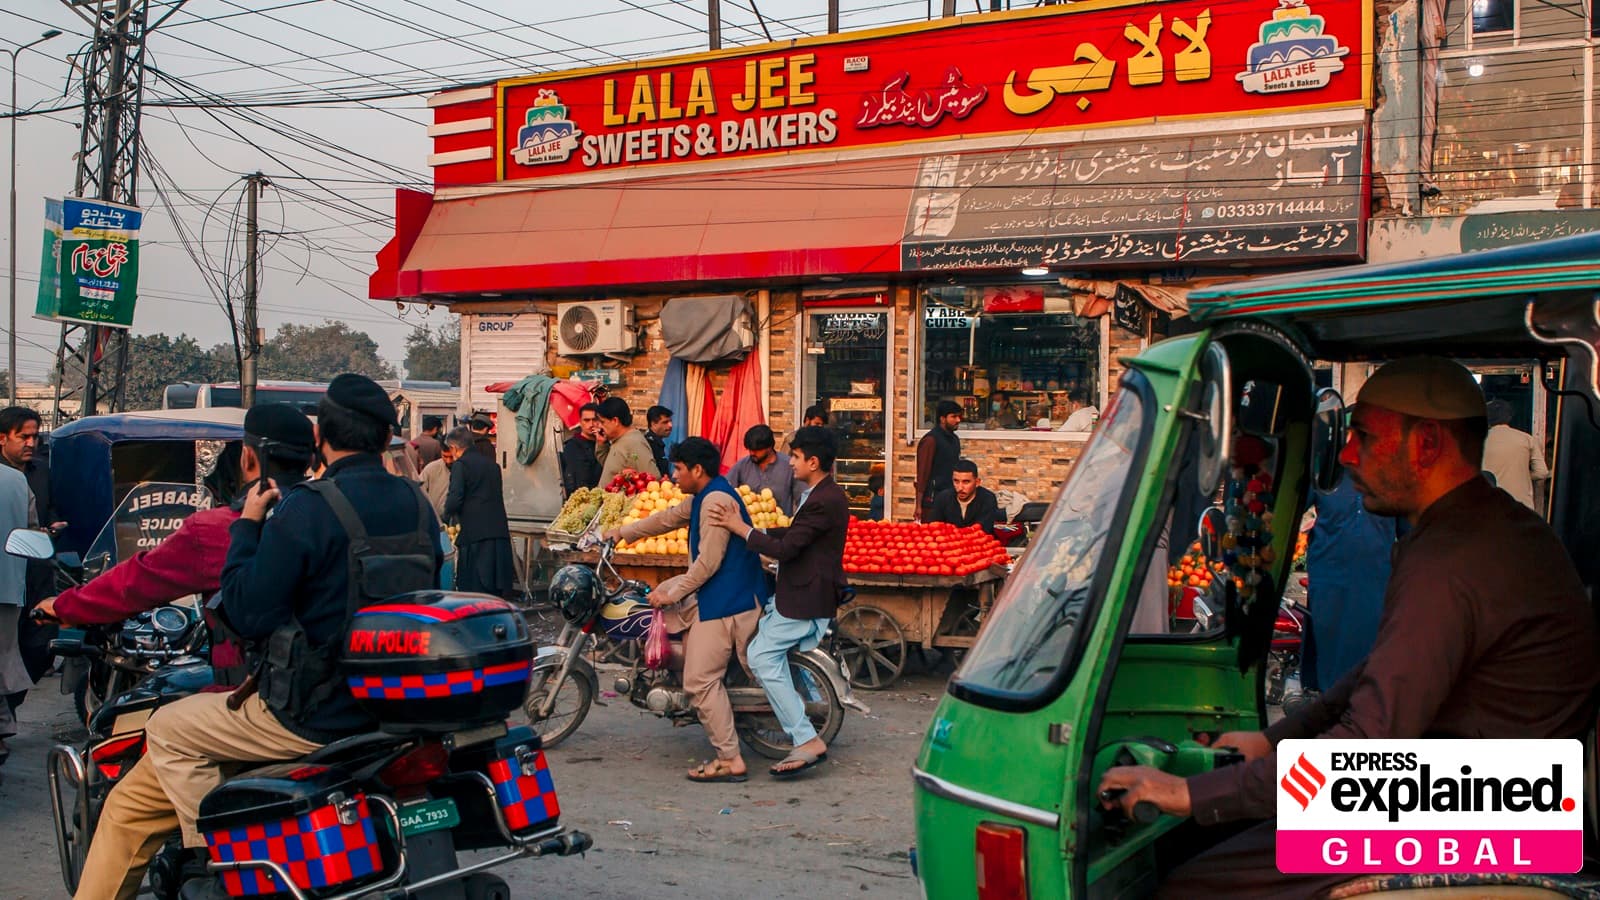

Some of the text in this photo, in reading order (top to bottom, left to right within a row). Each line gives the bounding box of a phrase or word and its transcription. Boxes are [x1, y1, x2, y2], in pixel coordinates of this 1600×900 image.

[1003, 8, 1213, 116] لالا جی
[1263, 62, 1316, 83] LALA JEE
[603, 53, 817, 127] LALA JEE
[1264, 82, 1288, 91] Sweets
[1297, 79, 1320, 87] Bakers
[922, 72, 983, 123] سویٹس
[528, 140, 561, 157] LALA JEE
[582, 107, 838, 168] SWEETS & BAKERS
[1265, 127, 1359, 158] سلمان
[1217, 199, 1326, 218] 03333714444
[478, 321, 514, 332] GROUP
[350, 630, 432, 655] KPK POLICE
[400, 815, 423, 828] GAA
[425, 808, 449, 821] 7933
